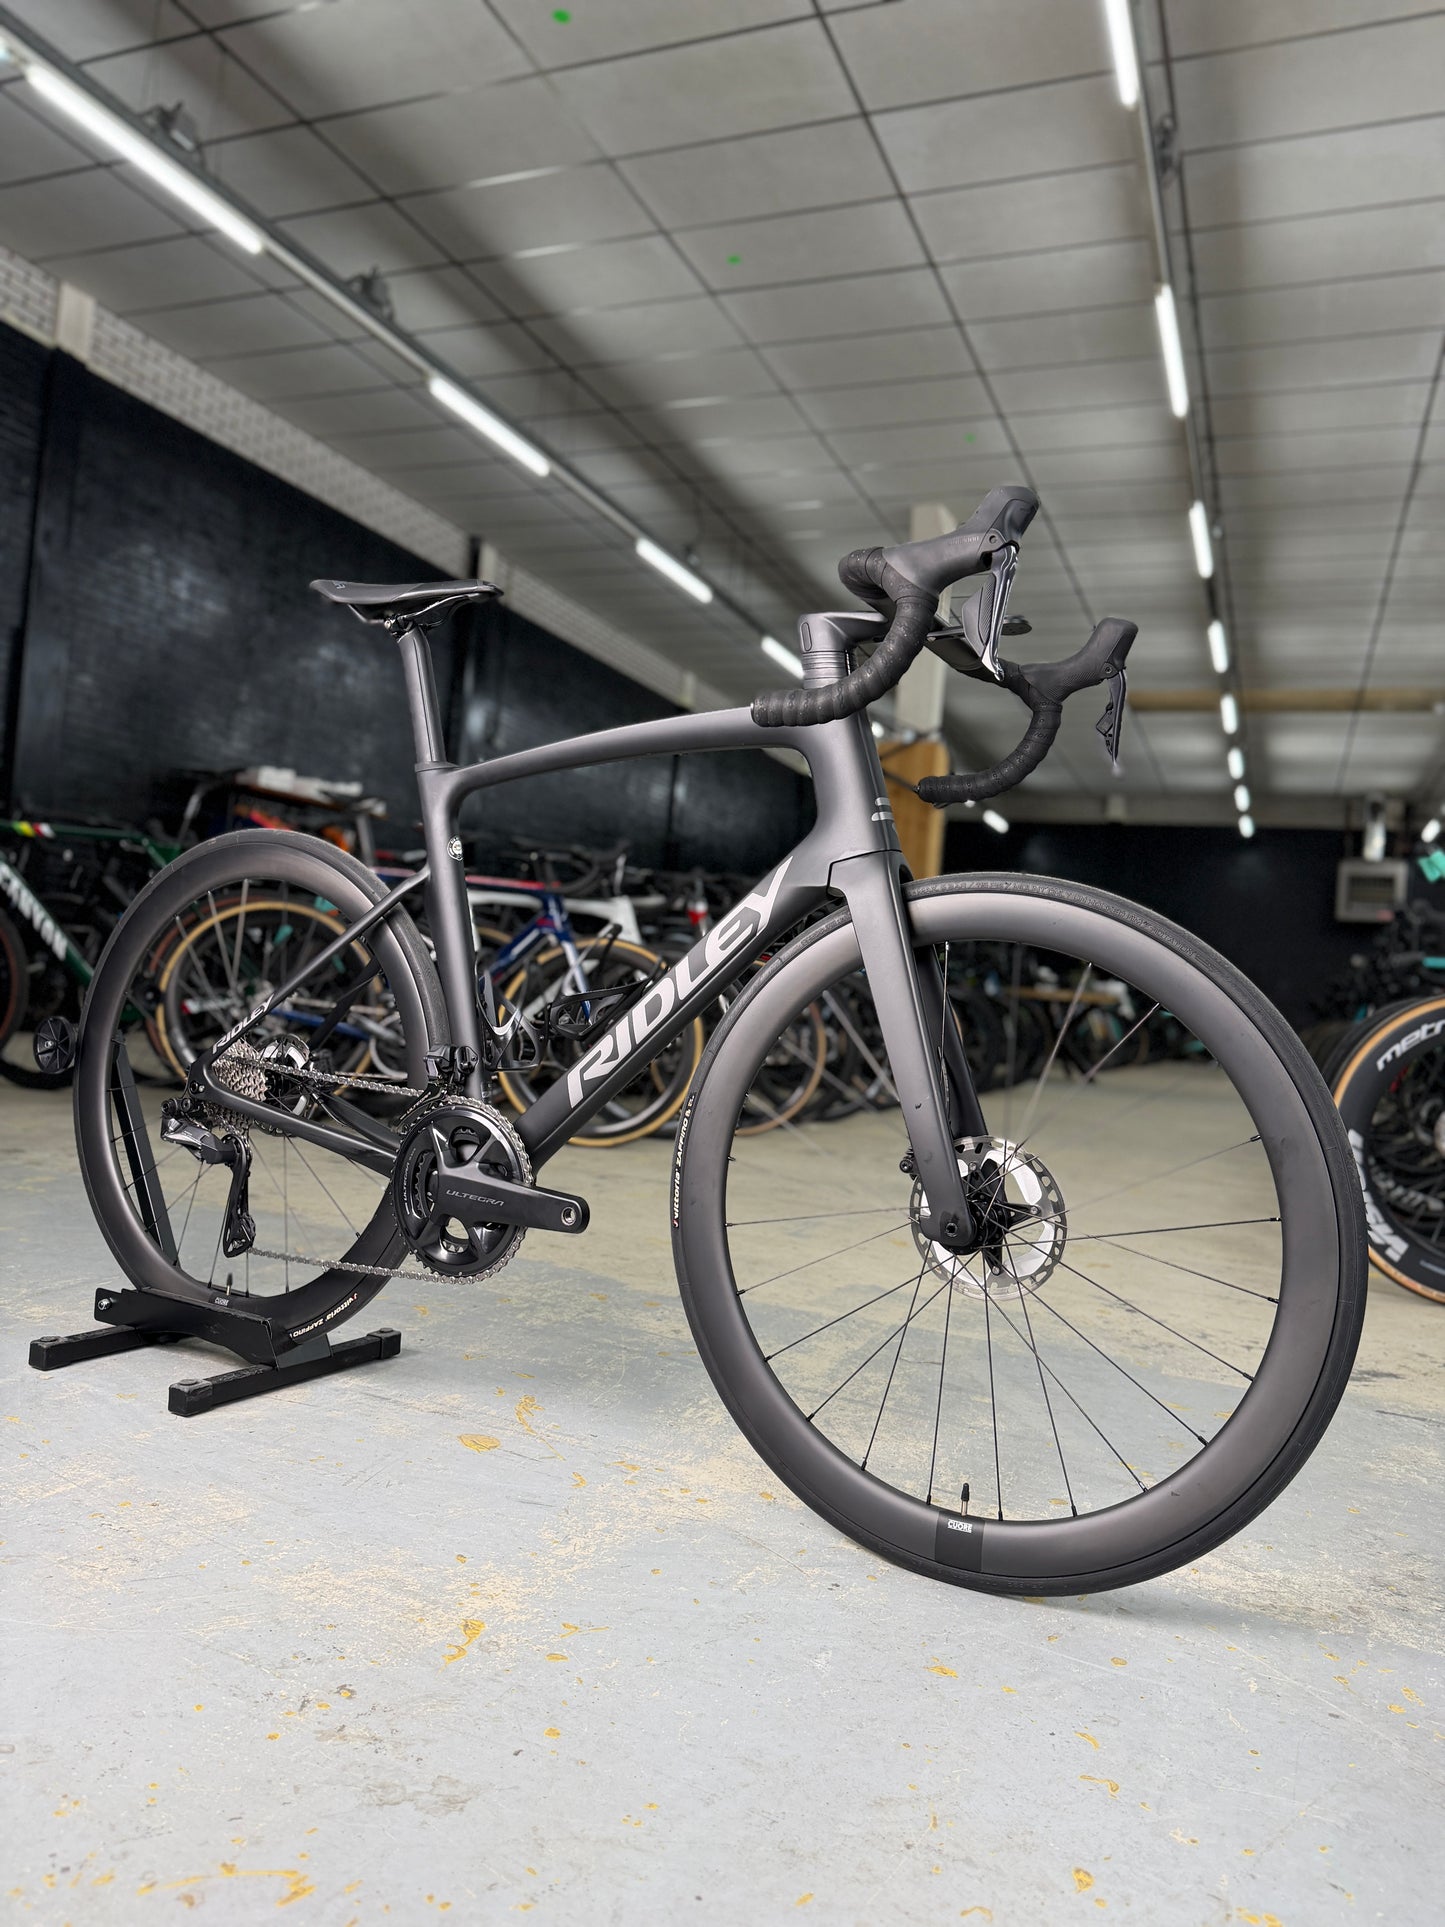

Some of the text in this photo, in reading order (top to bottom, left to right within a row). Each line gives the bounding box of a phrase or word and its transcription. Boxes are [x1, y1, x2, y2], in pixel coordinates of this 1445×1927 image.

[567, 855, 794, 1109] RIDLEY
[212, 993, 275, 1055] RIDLEY
[445, 1188, 505, 1207] ULTEGRA
[947, 1518, 973, 1534] CUORE
